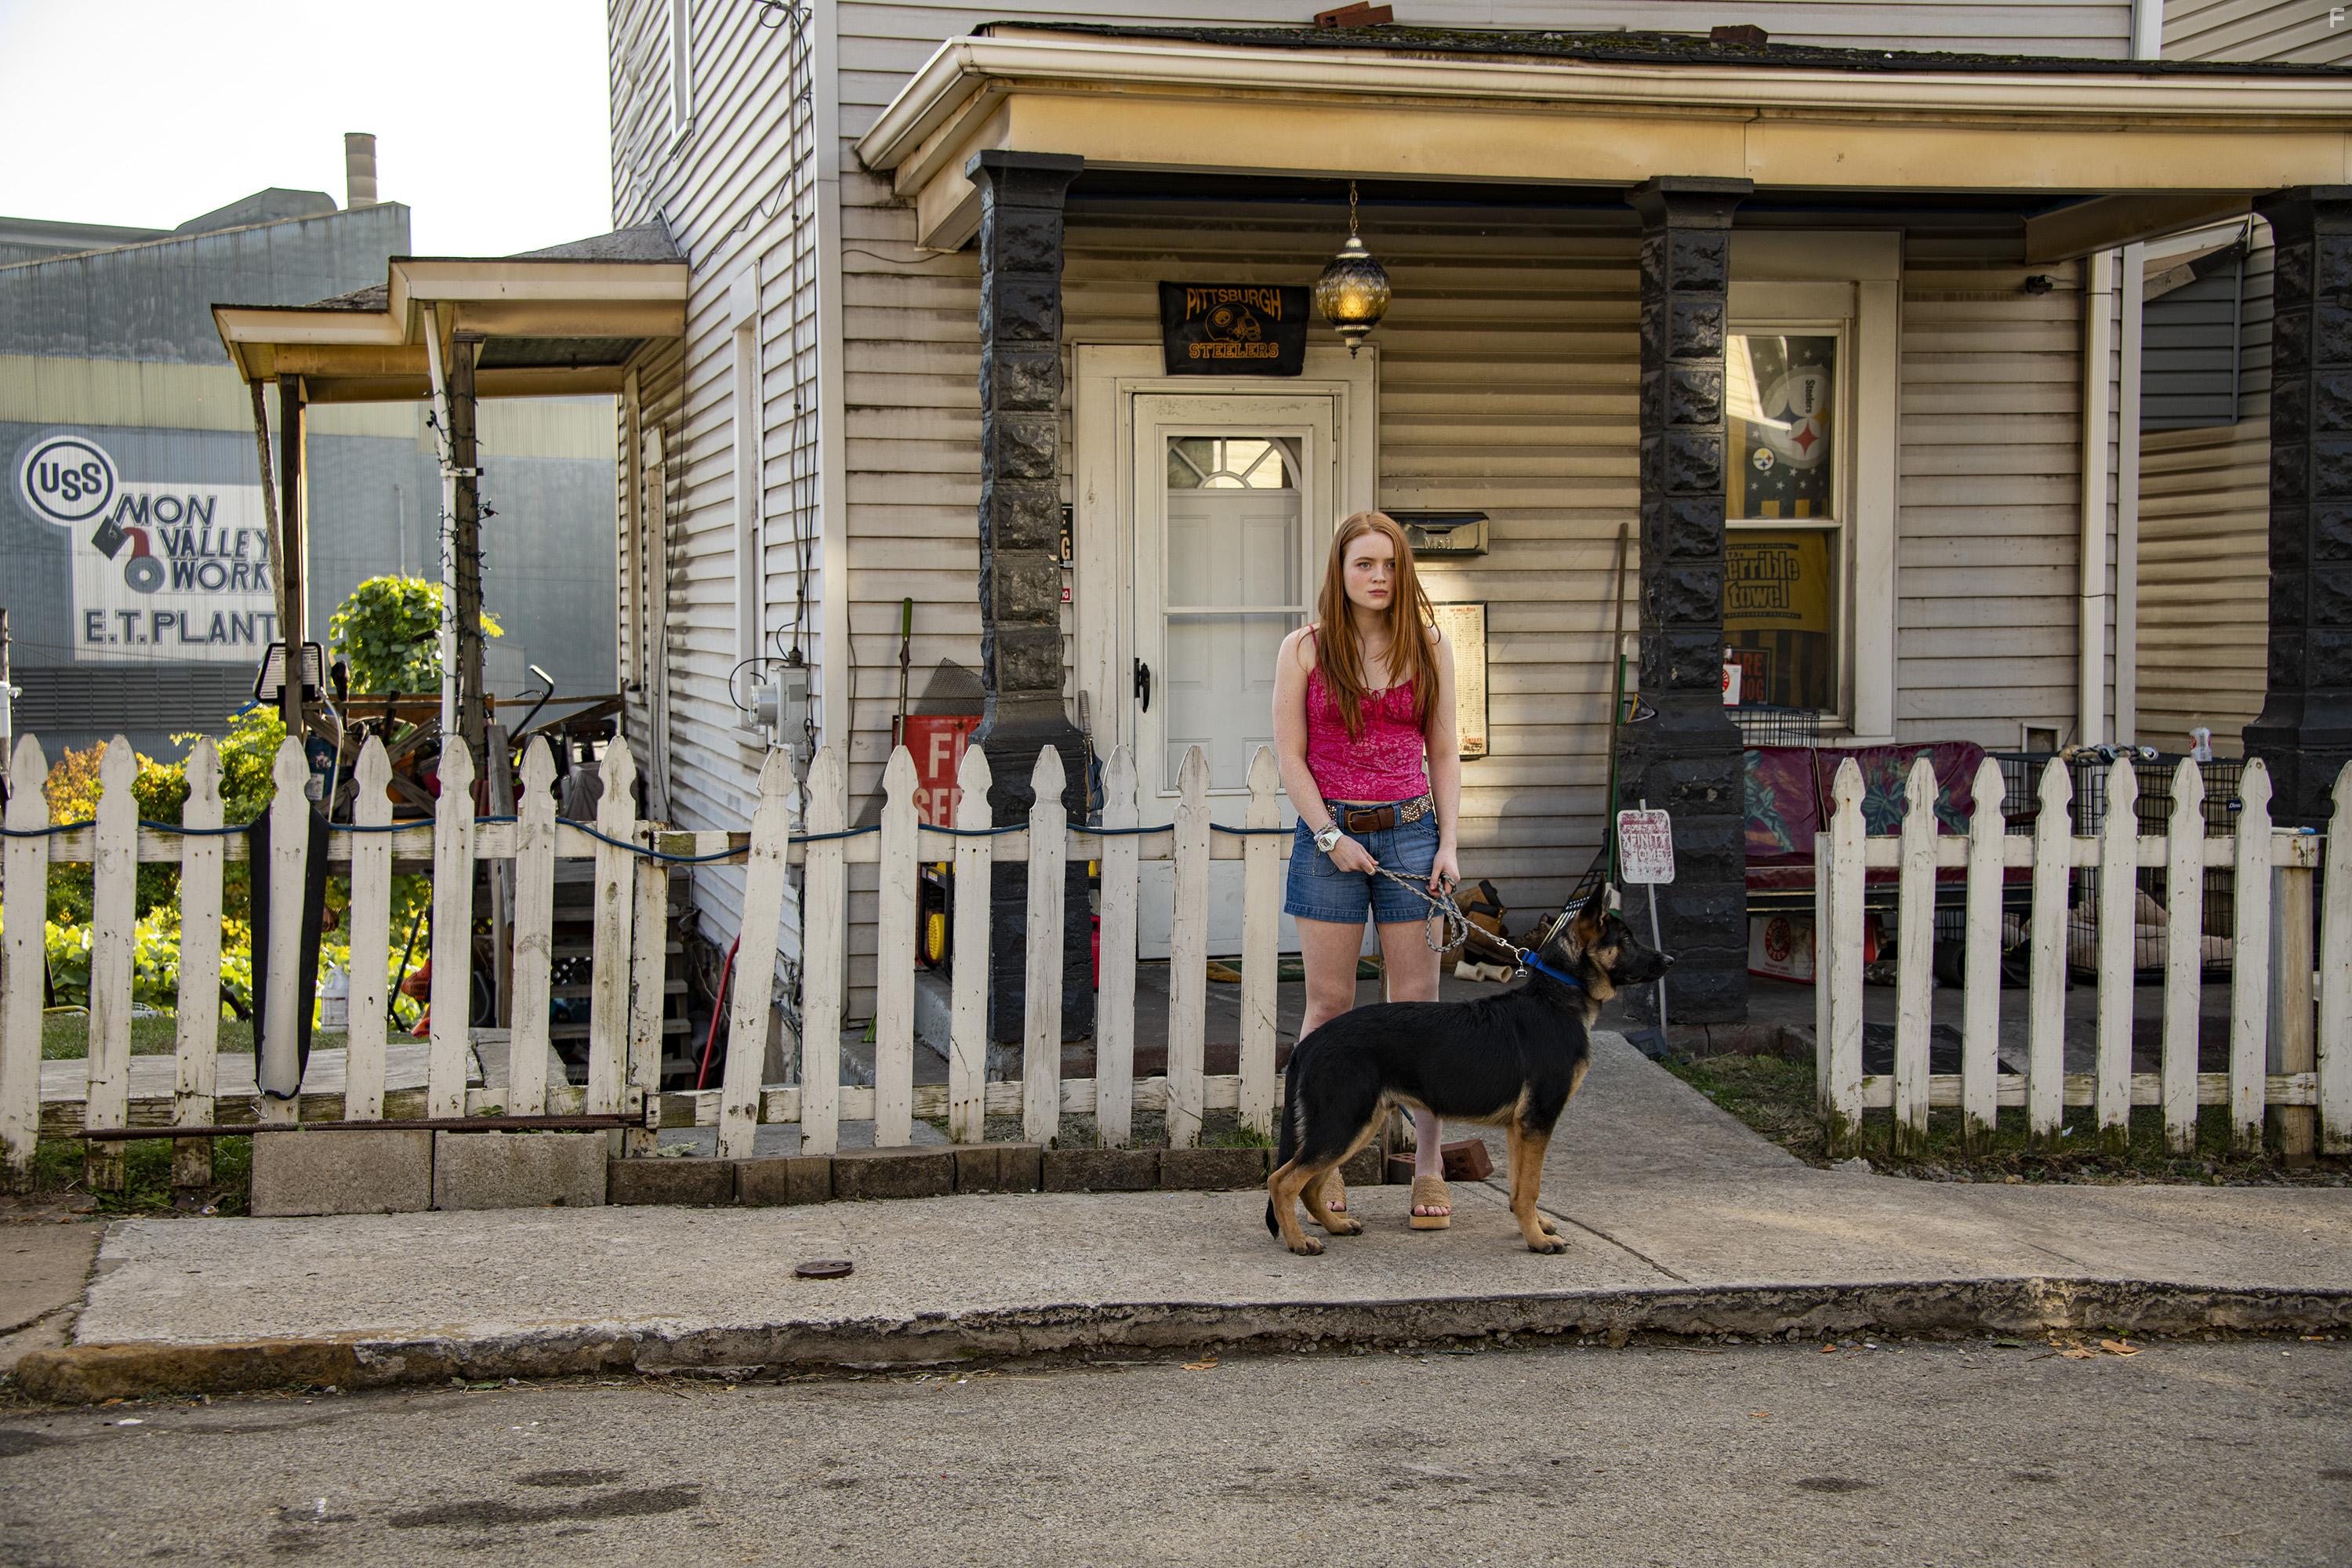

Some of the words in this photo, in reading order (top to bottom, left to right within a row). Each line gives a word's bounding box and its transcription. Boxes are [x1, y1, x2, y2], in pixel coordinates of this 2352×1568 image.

[1185, 288, 1282, 321] PITTSBURGH
[1189, 342, 1279, 358] STEELERS
[40, 463, 103, 502] USS
[112, 494, 217, 527] MON
[159, 527, 270, 560] VALLEY
[1423, 536, 1454, 550] Mail
[1722, 551, 1800, 581] errible
[1728, 581, 1789, 608] towel
[1622, 833, 1667, 848] XFINITY
